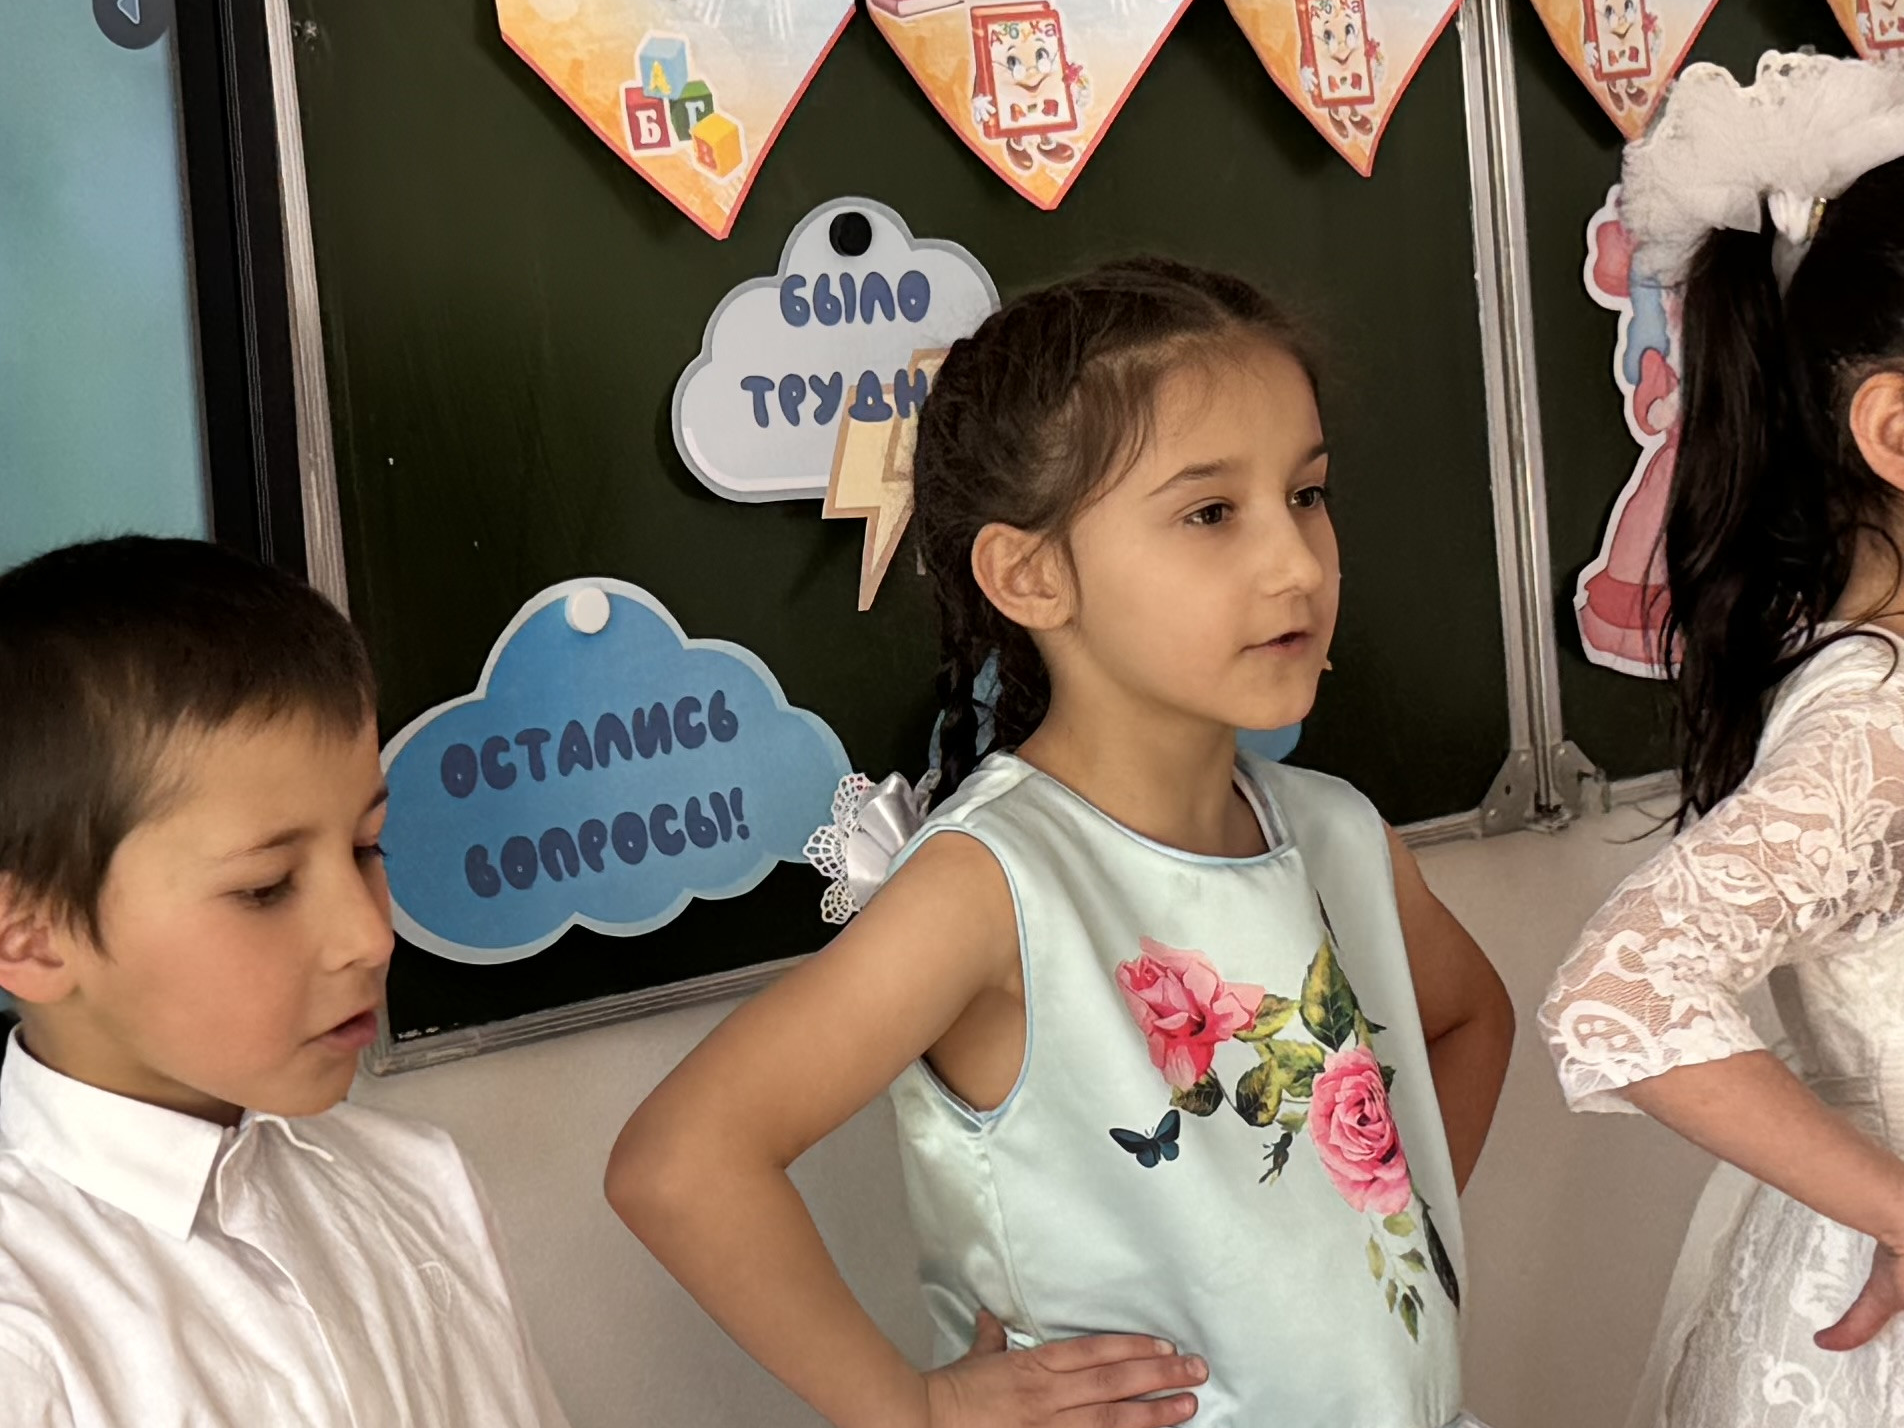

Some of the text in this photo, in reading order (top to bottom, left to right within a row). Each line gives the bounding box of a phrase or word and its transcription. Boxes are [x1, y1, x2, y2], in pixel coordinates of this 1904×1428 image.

[635, 109, 661, 144] Б
[780, 270, 931, 327] БЫЛО
[740, 368, 928, 428] ТРУДН
[439, 689, 739, 801] ОСТАЛИСЬ
[464, 786, 750, 898] ВОПРОСЫ!
